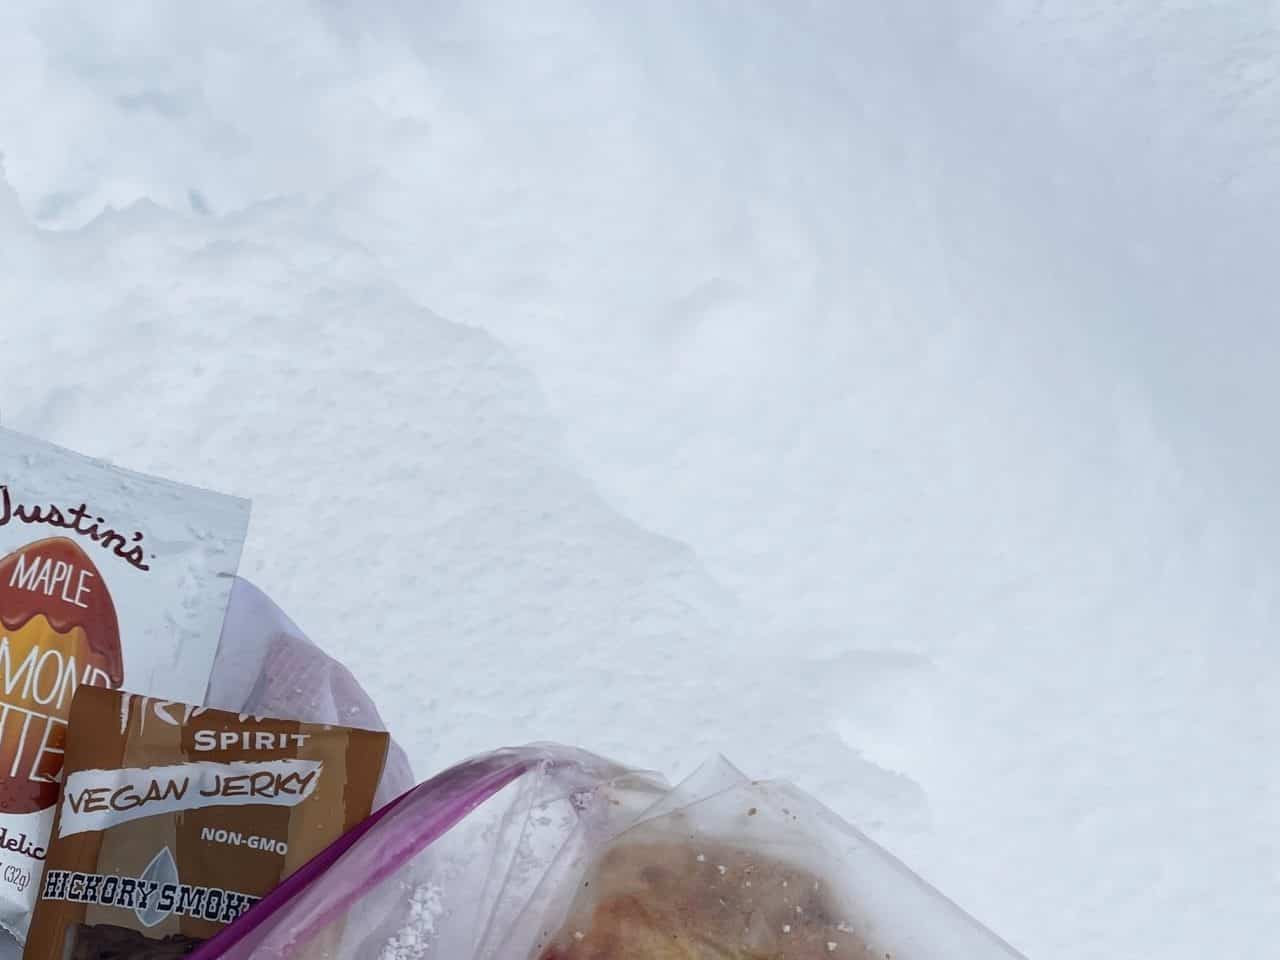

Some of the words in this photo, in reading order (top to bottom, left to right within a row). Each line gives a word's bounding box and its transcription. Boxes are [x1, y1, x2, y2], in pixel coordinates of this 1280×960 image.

[9, 553, 94, 608] MAPLE
[193, 729, 312, 751] SPIRIT
[68, 777, 190, 814] VEGAN
[200, 770, 318, 797] JERKY
[200, 827, 288, 855] NON-GMO
[4, 863, 31, 892] (32g)
[43, 869, 158, 911] HICKORY
